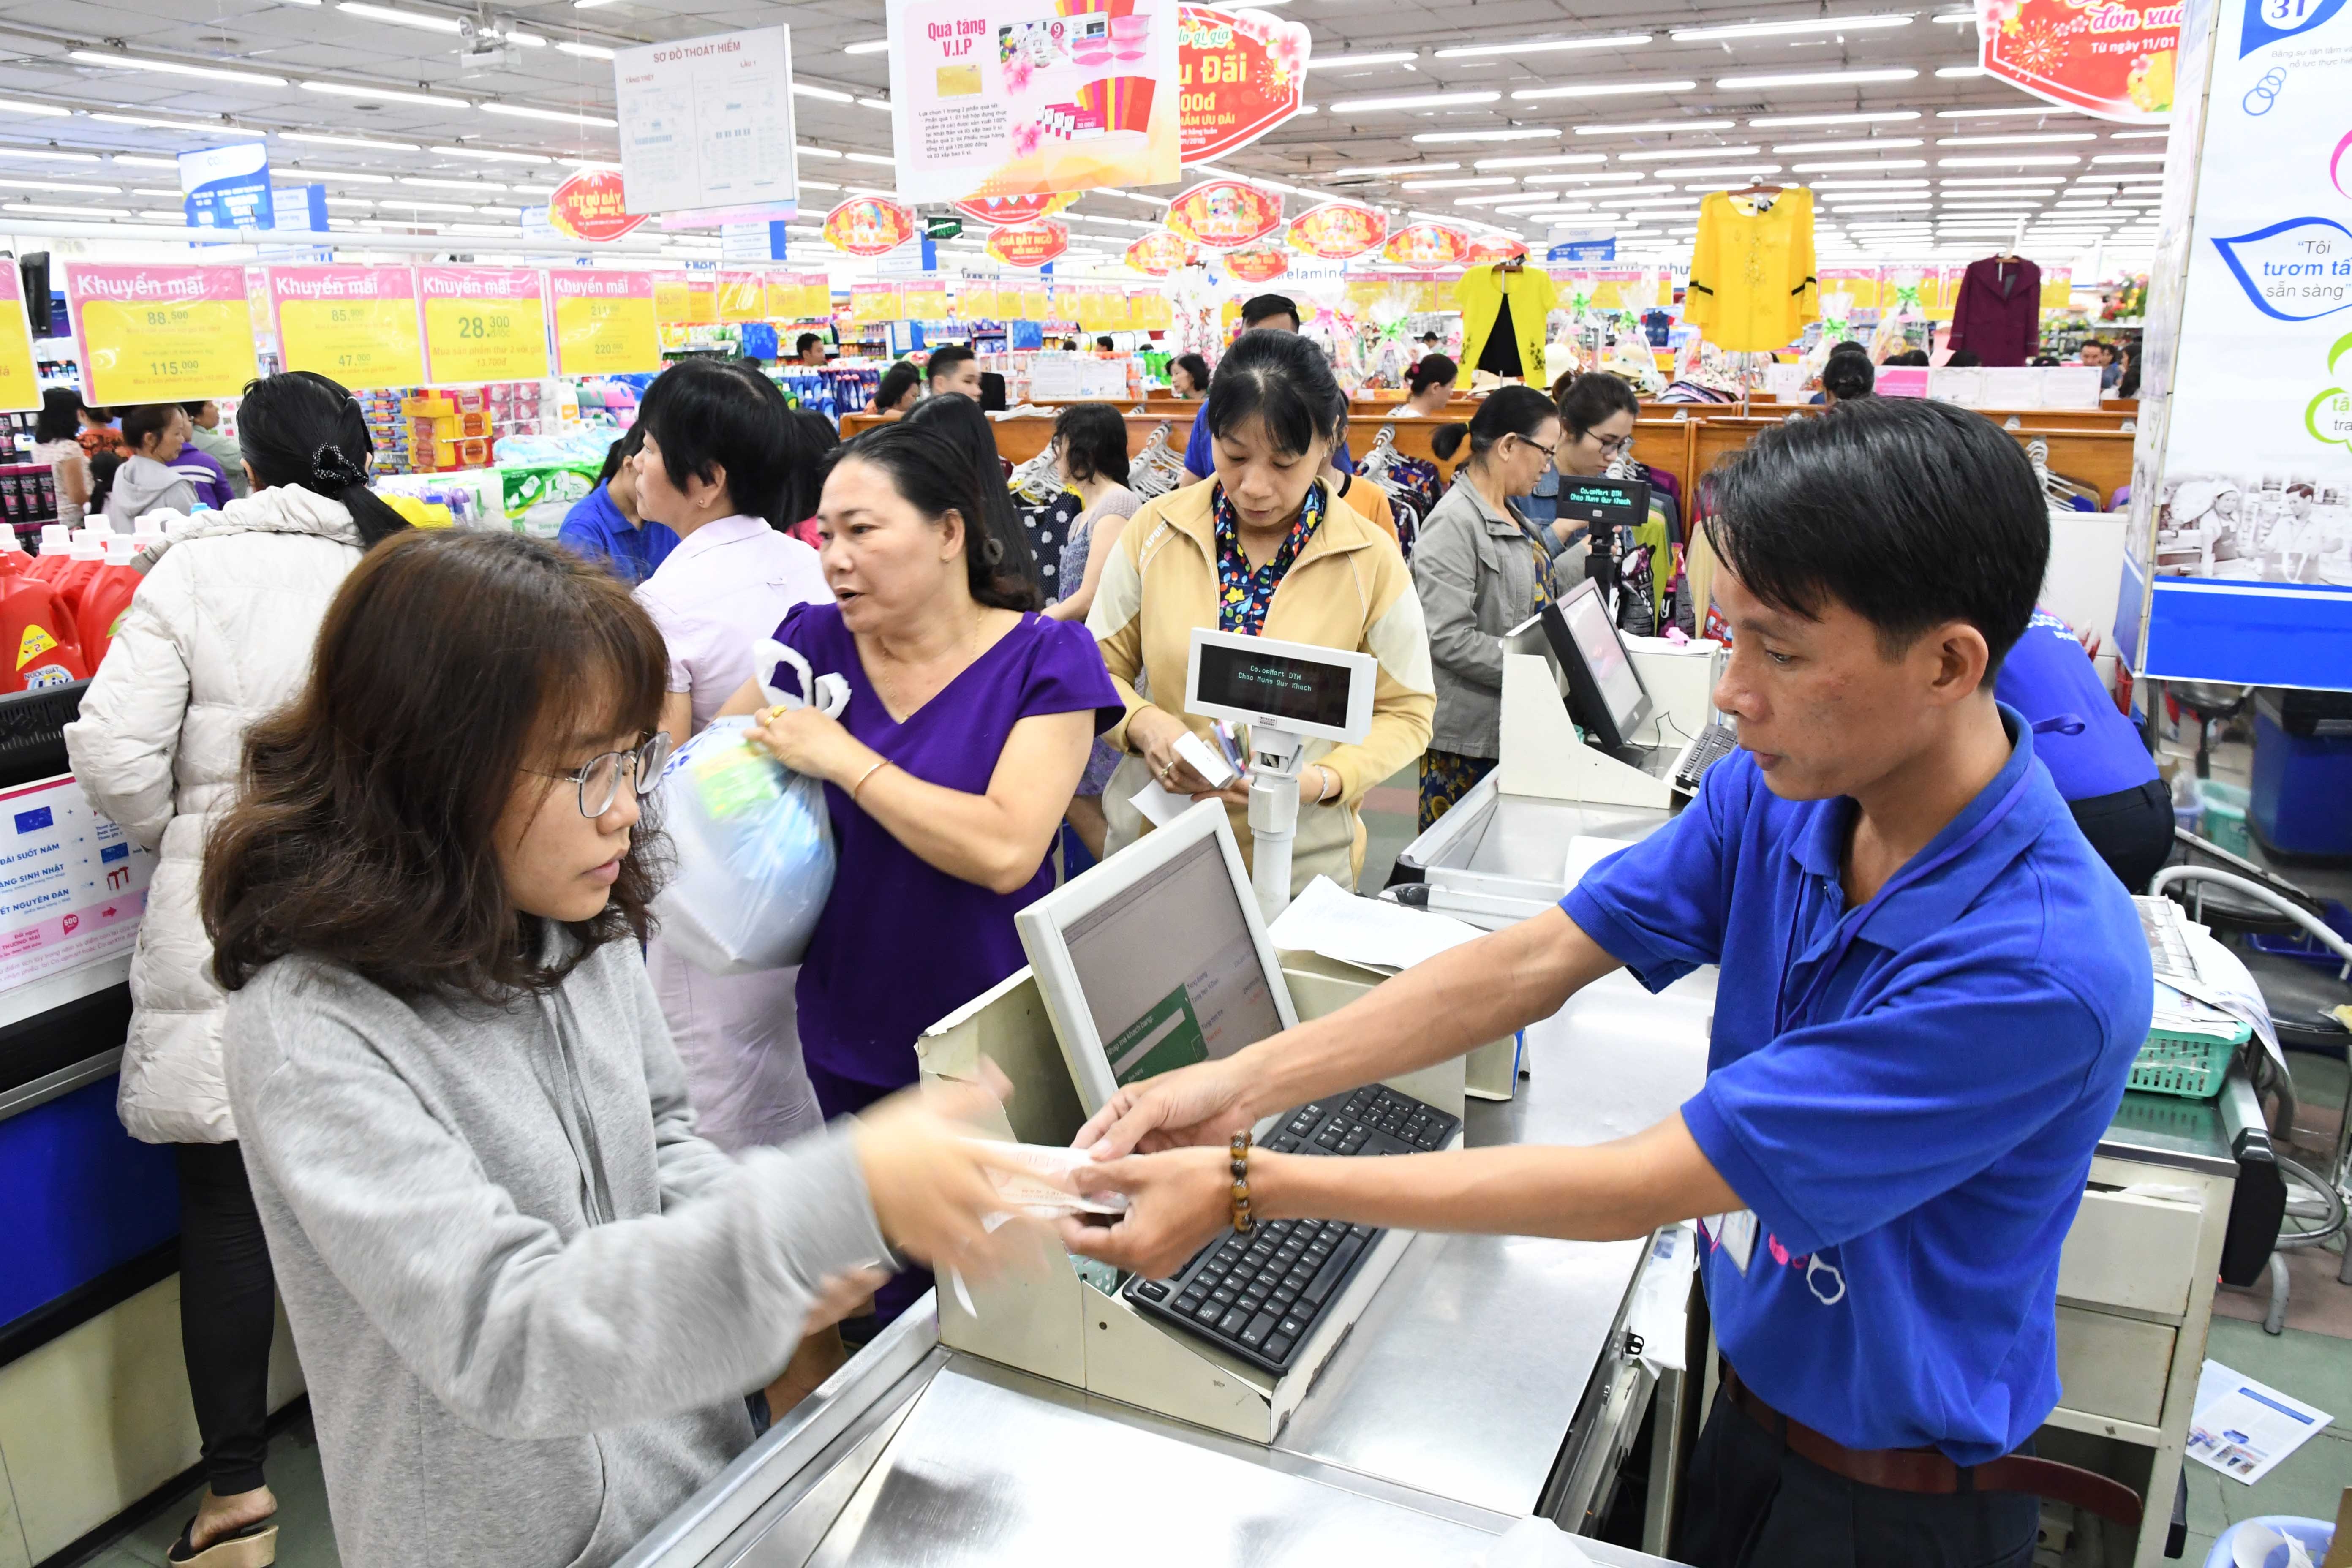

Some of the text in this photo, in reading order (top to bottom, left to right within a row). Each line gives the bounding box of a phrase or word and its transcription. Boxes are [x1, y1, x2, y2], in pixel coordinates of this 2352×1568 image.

[928, 17, 985, 41] Quà tặng
[1054, 24, 1061, 35] 9
[653, 38, 741, 63] SƠ ĐỒ THOÁT HIỂM
[943, 38, 972, 57] V.I.P
[2091, 42, 2106, 53] Từ
[2109, 40, 2139, 54] ngày
[1200, 52, 1247, 84] Đãi
[1278, 267, 1345, 280] elamine
[2263, 260, 2323, 276] tươm
[77, 272, 205, 299] Khuyến mãi
[275, 275, 378, 299] Khuyến mãi
[423, 275, 510, 297] Khuyến mãi
[554, 276, 628, 297] Khuyến mãi
[2265, 280, 2297, 297] sẵn
[458, 316, 510, 338] 28.300
[1250, 665, 1284, 677] Co.opMart
[1238, 672, 1253, 681] Chao
[1257, 676, 1273, 684] Mung
[1292, 682, 1312, 691] Khach
[17, 848, 37, 860] SUỐT
[40, 843, 60, 854] NĂM
[19, 871, 40, 882] SINH
[42, 864, 64, 875] NHẬT
[13, 895, 49, 911] NGUYÊN
[51, 888, 69, 899] ĐÁN
[64, 917, 77, 926] 500
